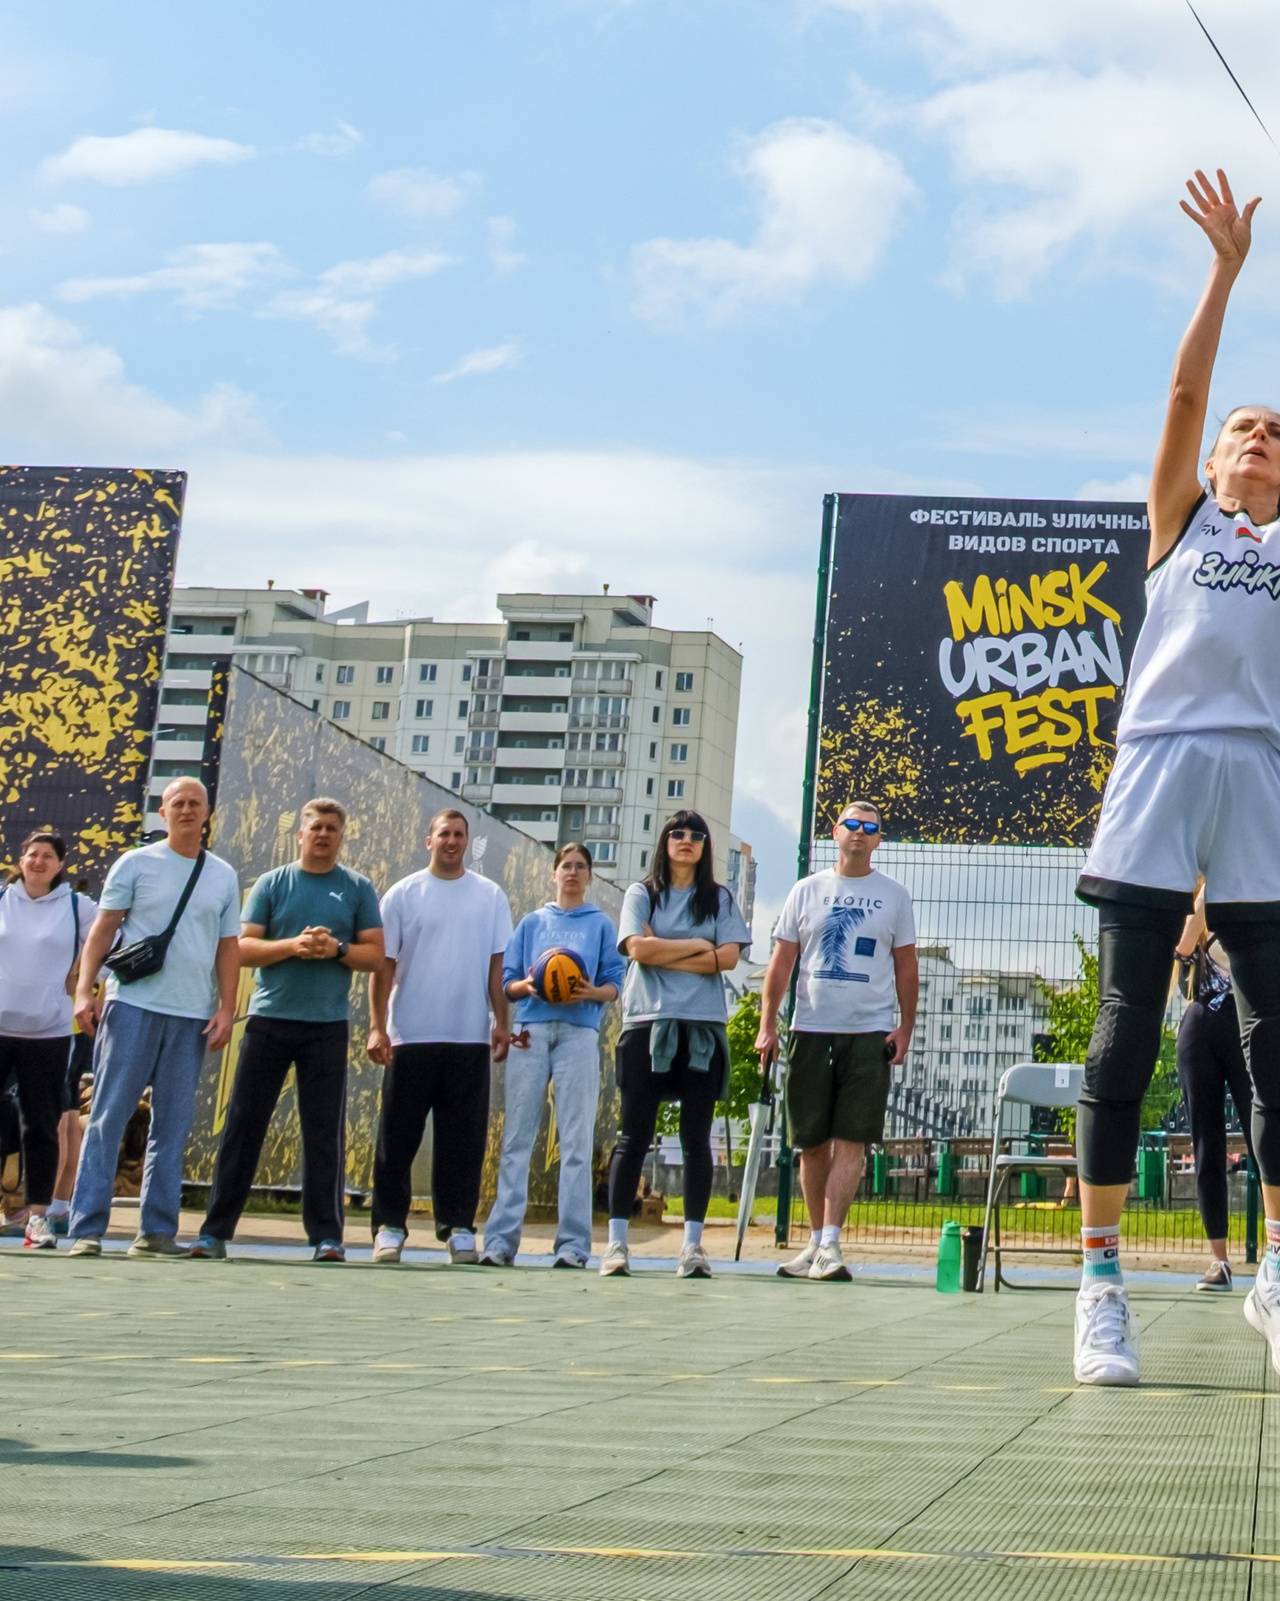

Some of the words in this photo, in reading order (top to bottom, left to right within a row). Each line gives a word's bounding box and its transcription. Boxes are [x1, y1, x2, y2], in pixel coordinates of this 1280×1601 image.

[910, 508, 1047, 528] ФЕСТИВАЛЬ
[1052, 512, 1151, 530] УЛИЧНЫ
[948, 534, 1027, 554] ВИДОВ
[1031, 537, 1121, 555] СПОРТА
[938, 618, 1125, 698] URBAN
[955, 685, 1116, 761] FEST
[823, 895, 884, 910] EXOTIC
[539, 930, 587, 941] BOSTON
